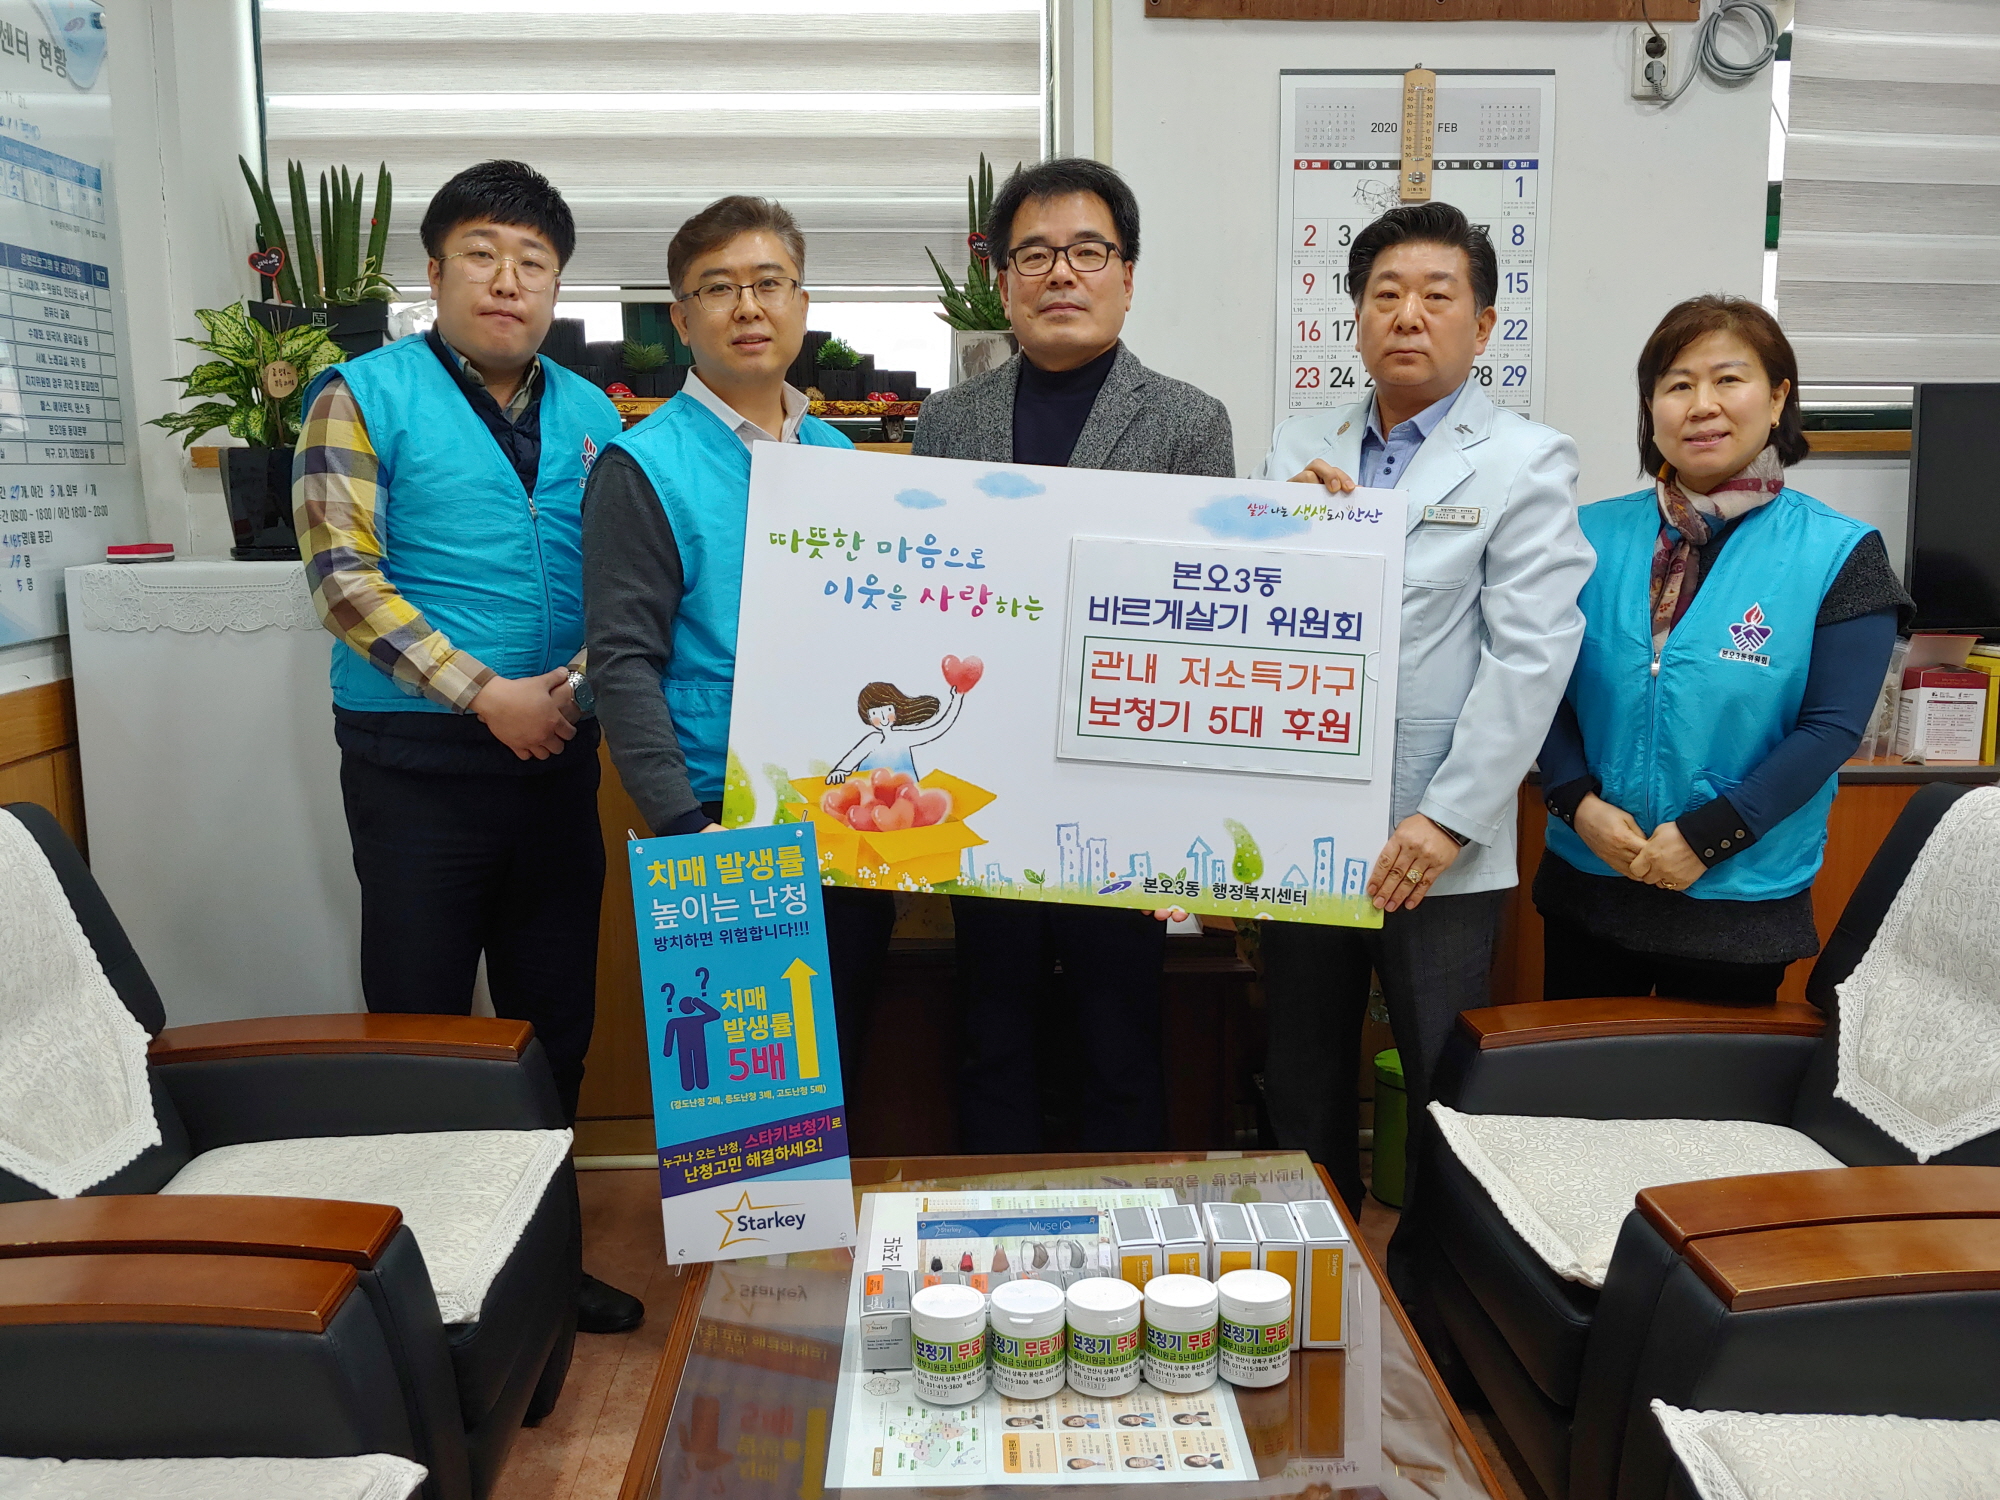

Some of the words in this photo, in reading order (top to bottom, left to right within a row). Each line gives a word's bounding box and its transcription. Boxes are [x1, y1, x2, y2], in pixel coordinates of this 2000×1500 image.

[38, 39, 67, 78] 현황
[1371, 122, 1398, 133] 2020
[1437, 122, 1458, 133] FEB
[1515, 175, 1523, 198] 1
[1303, 224, 1317, 246] 2
[1338, 224, 1351, 246] 3
[1511, 224, 1525, 246] 8
[1302, 272, 1316, 295] 9
[1505, 272, 1529, 294] 15
[1297, 320, 1321, 342] 16
[1332, 320, 1356, 342] 17
[1503, 318, 1528, 341] 22
[1295, 366, 1320, 389] 23
[1329, 366, 1355, 388] 24
[1502, 365, 1527, 387] 29
[30, 485, 43, 499] 야간
[1247, 503, 1269, 518] 살맛
[1271, 505, 1289, 518] 나는
[1347, 506, 1384, 524] 안산
[769, 526, 866, 562] 따뜻한
[876, 533, 986, 570] 마음으로
[24, 554, 31, 569] 명
[27, 577, 34, 592] 명
[1172, 560, 1283, 598] 본오3동
[824, 573, 908, 612] 이웃을
[919, 583, 1044, 621] 사랑하는
[1088, 595, 1250, 635] 바르게살기
[1265, 605, 1364, 643] 위원회
[1090, 649, 1159, 685] 관내
[1178, 656, 1356, 697] 저소득가구
[1087, 695, 1191, 733] 보청기
[1207, 704, 1265, 738] 5대
[1281, 707, 1352, 744] 후원
[646, 855, 707, 890] 치매
[715, 845, 806, 885] 발생률
[1142, 875, 1201, 898] 본오3동
[1211, 880, 1309, 907] 행정복지센터
[650, 891, 741, 930] 높이는
[749, 881, 808, 919] 난청
[653, 929, 714, 953] 방치하면
[718, 920, 811, 945] 위험합니다!!!
[720, 985, 768, 1014] 치매
[722, 1012, 794, 1044] 발생률
[728, 1041, 788, 1082] 5배
[776, 1086, 809, 1098] 고도난청
[662, 1154, 694, 1170] 누구나
[695, 1148, 717, 1163] 오는
[717, 1140, 743, 1158] 난청,
[744, 1114, 843, 1149] 스타키보청기로
[683, 1155, 743, 1184] 난청고민
[745, 1136, 824, 1169] 해결하세요!
[736, 1210, 807, 1232] Starkey
[1029, 1221, 1058, 1232] Muse
[1059, 1220, 1072, 1231] IQ
[882, 1236, 904, 1262] 조직도
[1332, 1253, 1340, 1278] Starkey
[1073, 1332, 1111, 1355] 보청기
[1147, 1325, 1182, 1352] 보청기
[1222, 1320, 1259, 1345] 보청기
[916, 1339, 952, 1362] 보청기
[1073, 1350, 1106, 1365] 정부지원금
[1107, 1352, 1131, 1365] 5년마다
[1178, 1351, 1204, 1362] 5년마다
[1222, 1338, 1254, 1355] 정부지원금
[1256, 1343, 1280, 1355] 5년마다
[917, 1357, 947, 1373] 정부지원금
[949, 1359, 974, 1372] 5년마다
[1015, 1358, 1042, 1368] 5년마다
[1231, 1362, 1269, 1372] 031-415-3800
[926, 1381, 963, 1390] 031-415-3800
[1083, 1374, 1121, 1383] 031-415-3800
